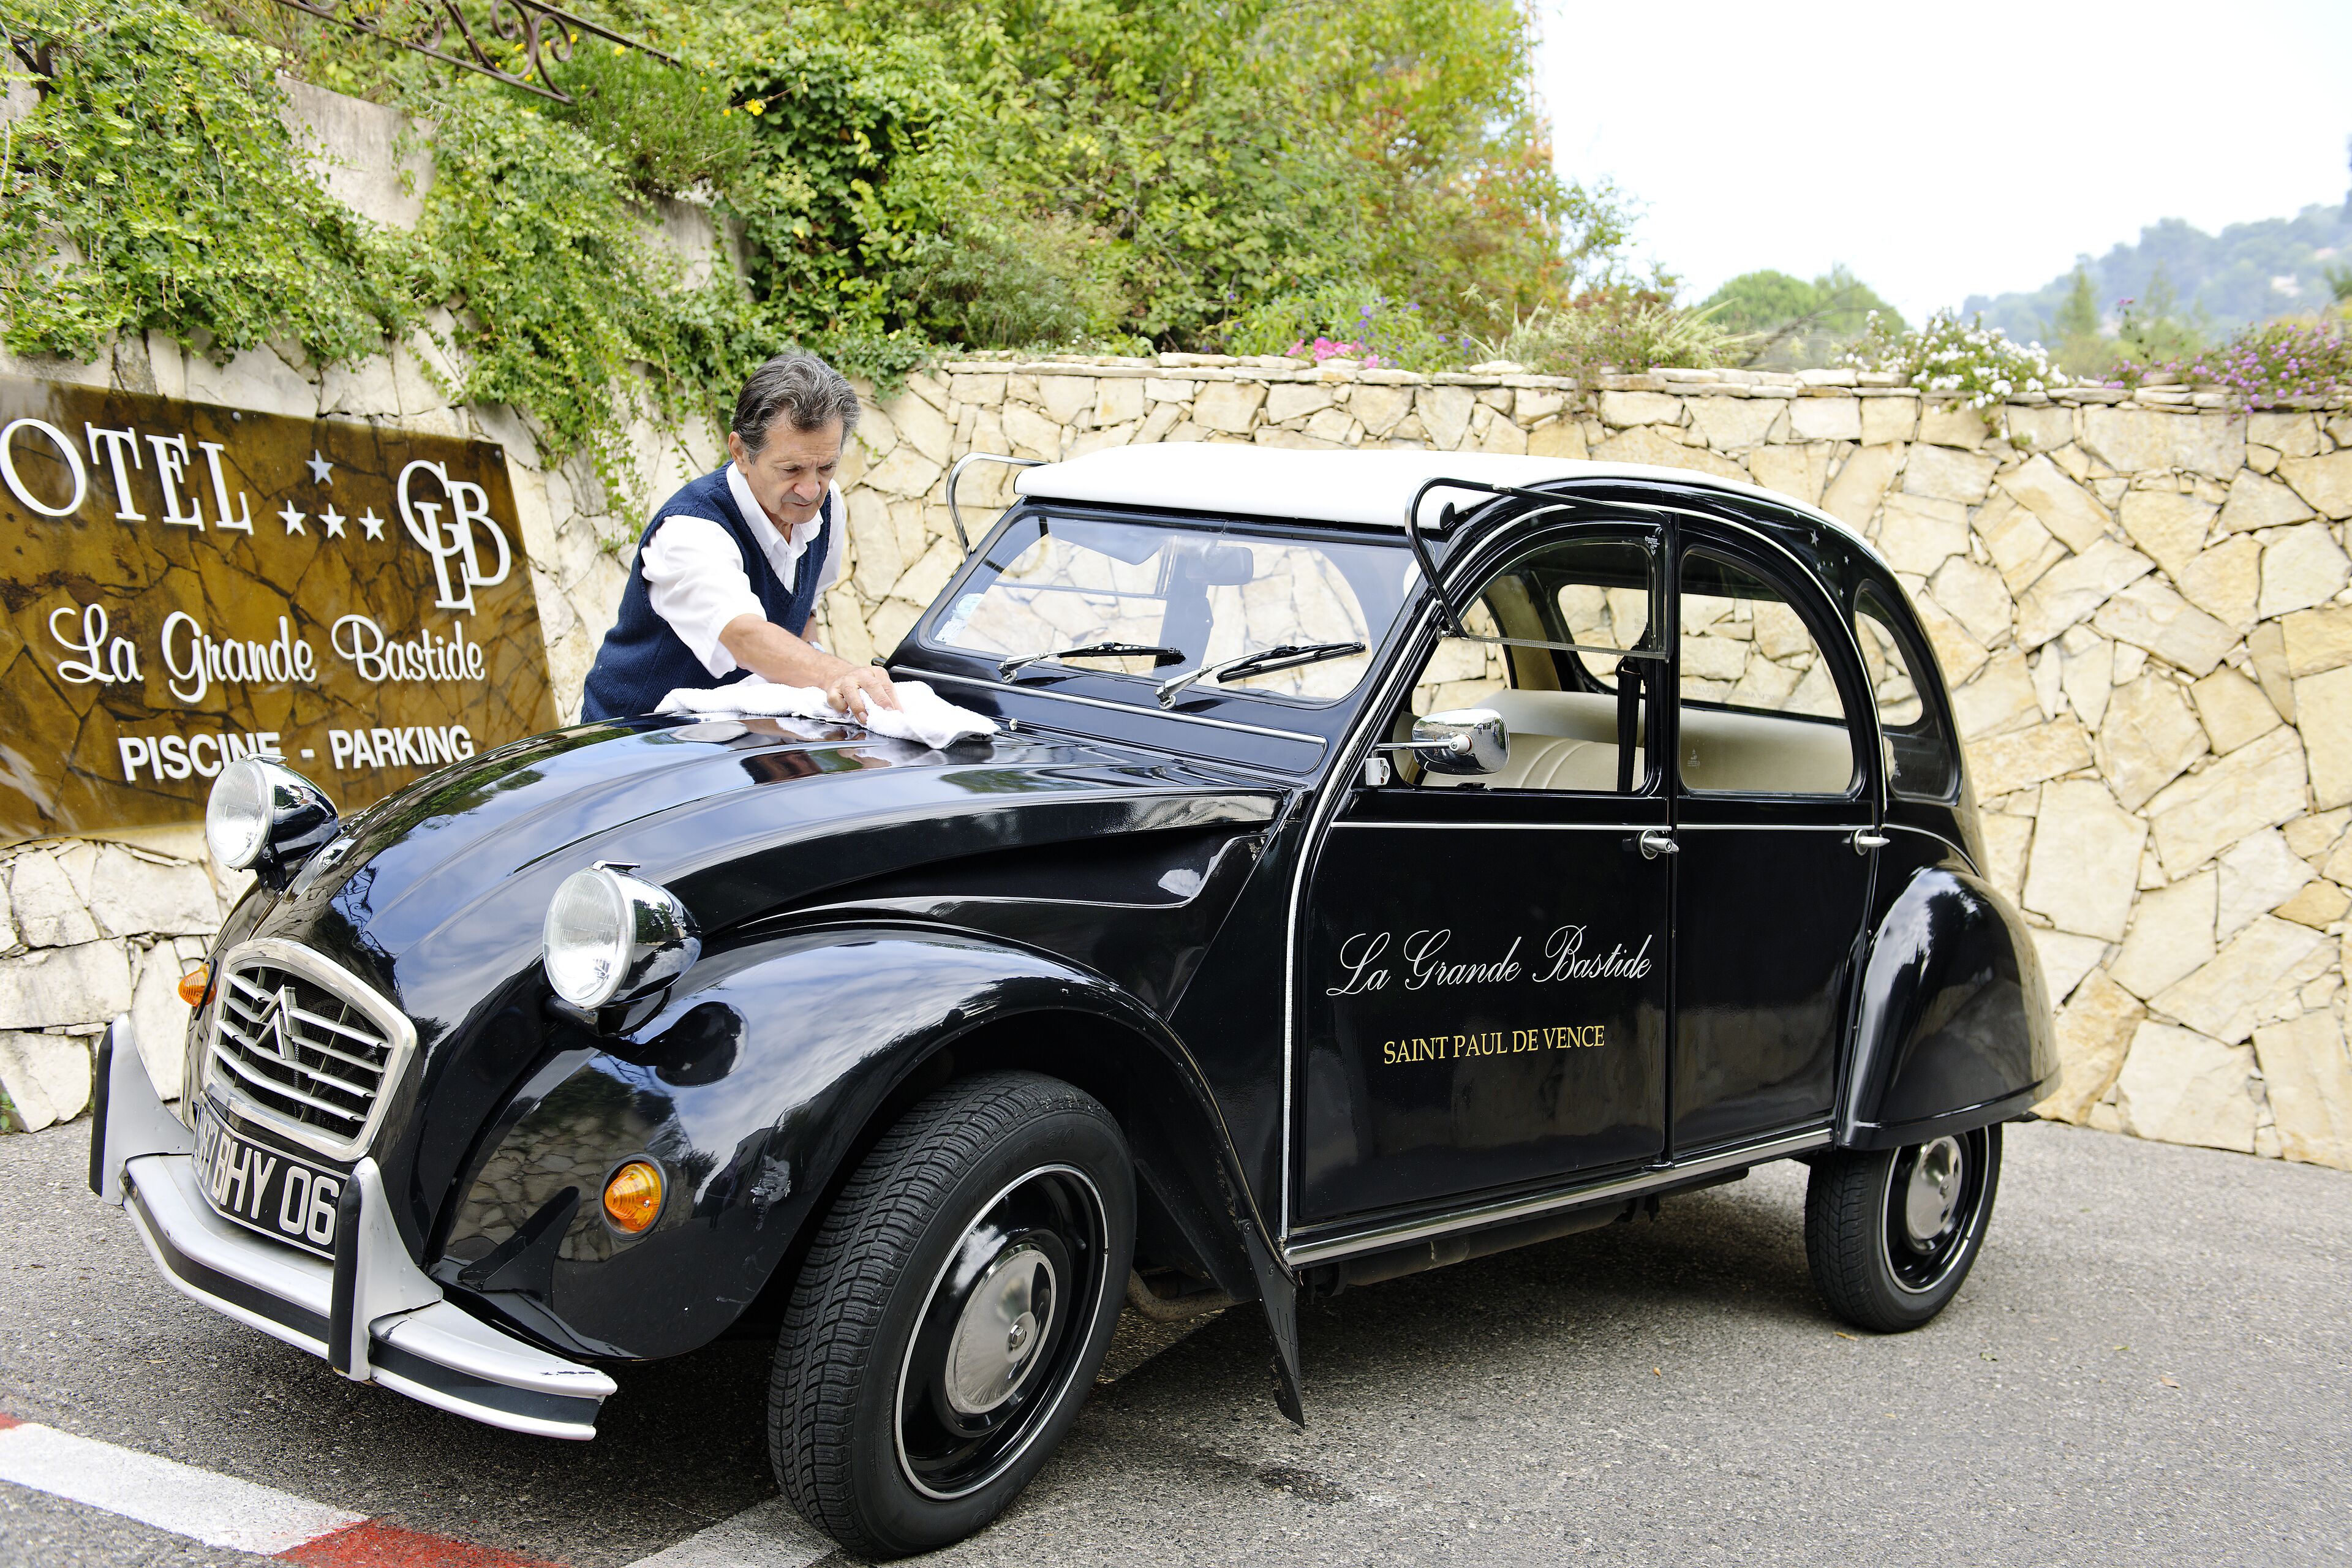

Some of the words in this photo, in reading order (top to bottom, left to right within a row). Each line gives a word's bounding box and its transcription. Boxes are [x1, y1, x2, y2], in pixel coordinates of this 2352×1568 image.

[0, 418, 254, 536] OTEL
[49, 603, 145, 684] La
[161, 611, 317, 703] Grande
[331, 614, 486, 682] Bastide
[328, 725, 475, 770] PARKING
[1325, 932, 1391, 997] La
[1403, 929, 1522, 990] Grande
[1532, 925, 1653, 982] Bastide
[1383, 1036, 1449, 1065] SAINT
[1453, 1032, 1508, 1058] PAUL
[1512, 1029, 1539, 1053] DE
[1542, 1025, 1605, 1049] VENCE
[279, 1165, 340, 1246] 06
